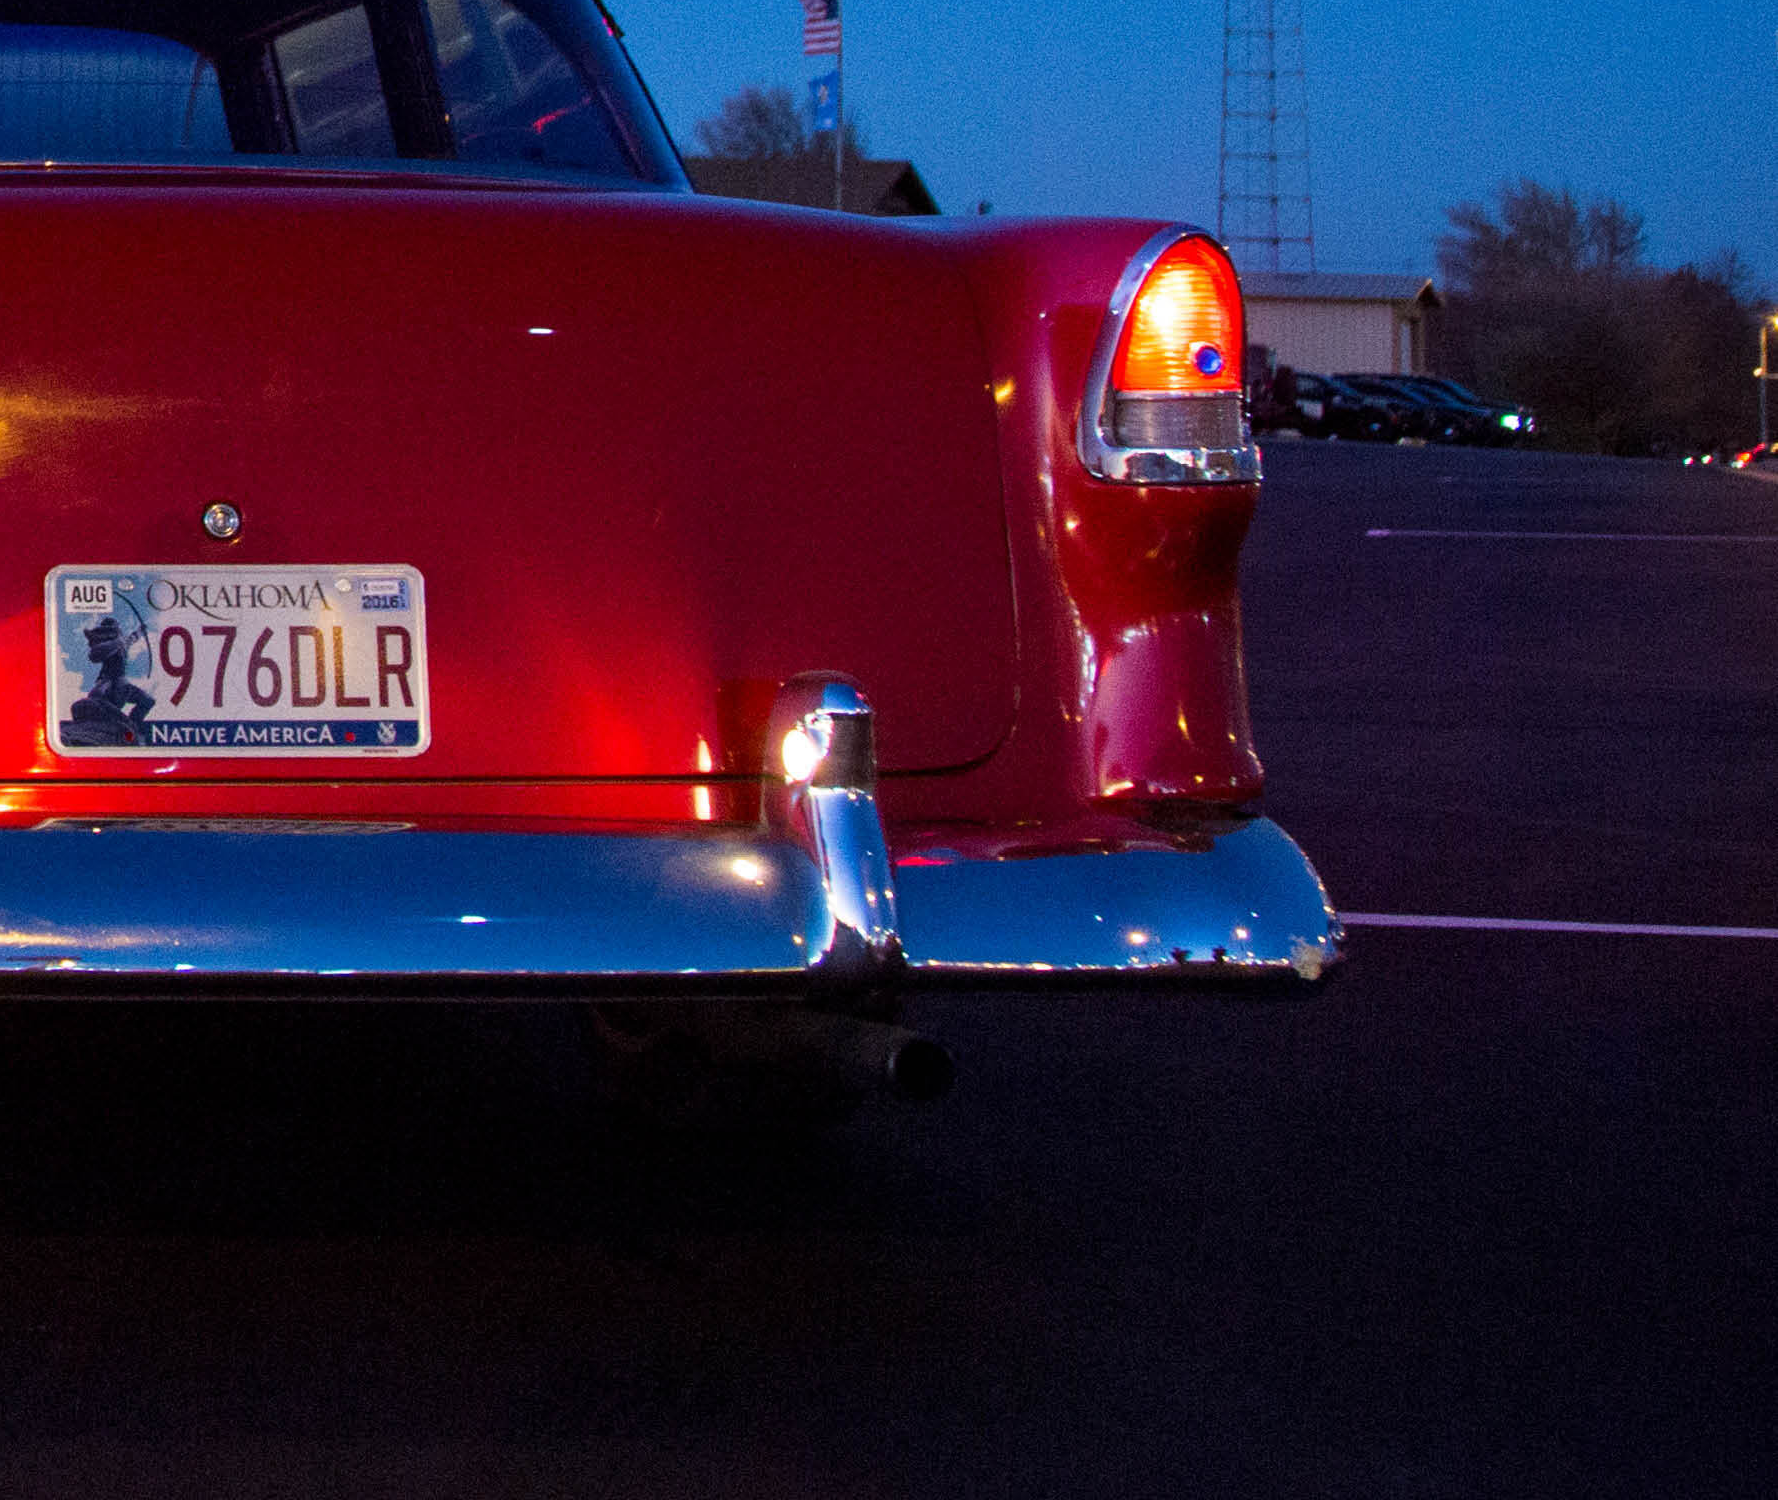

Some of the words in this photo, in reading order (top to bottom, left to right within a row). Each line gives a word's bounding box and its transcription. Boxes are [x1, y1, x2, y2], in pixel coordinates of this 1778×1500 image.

[71, 585, 107, 603] AUG
[147, 579, 334, 621] OKLAHOMA
[362, 595, 399, 609] 2016
[159, 626, 414, 708] 976DLR
[152, 724, 228, 745] NATIVE
[233, 724, 335, 745] AMERICA
